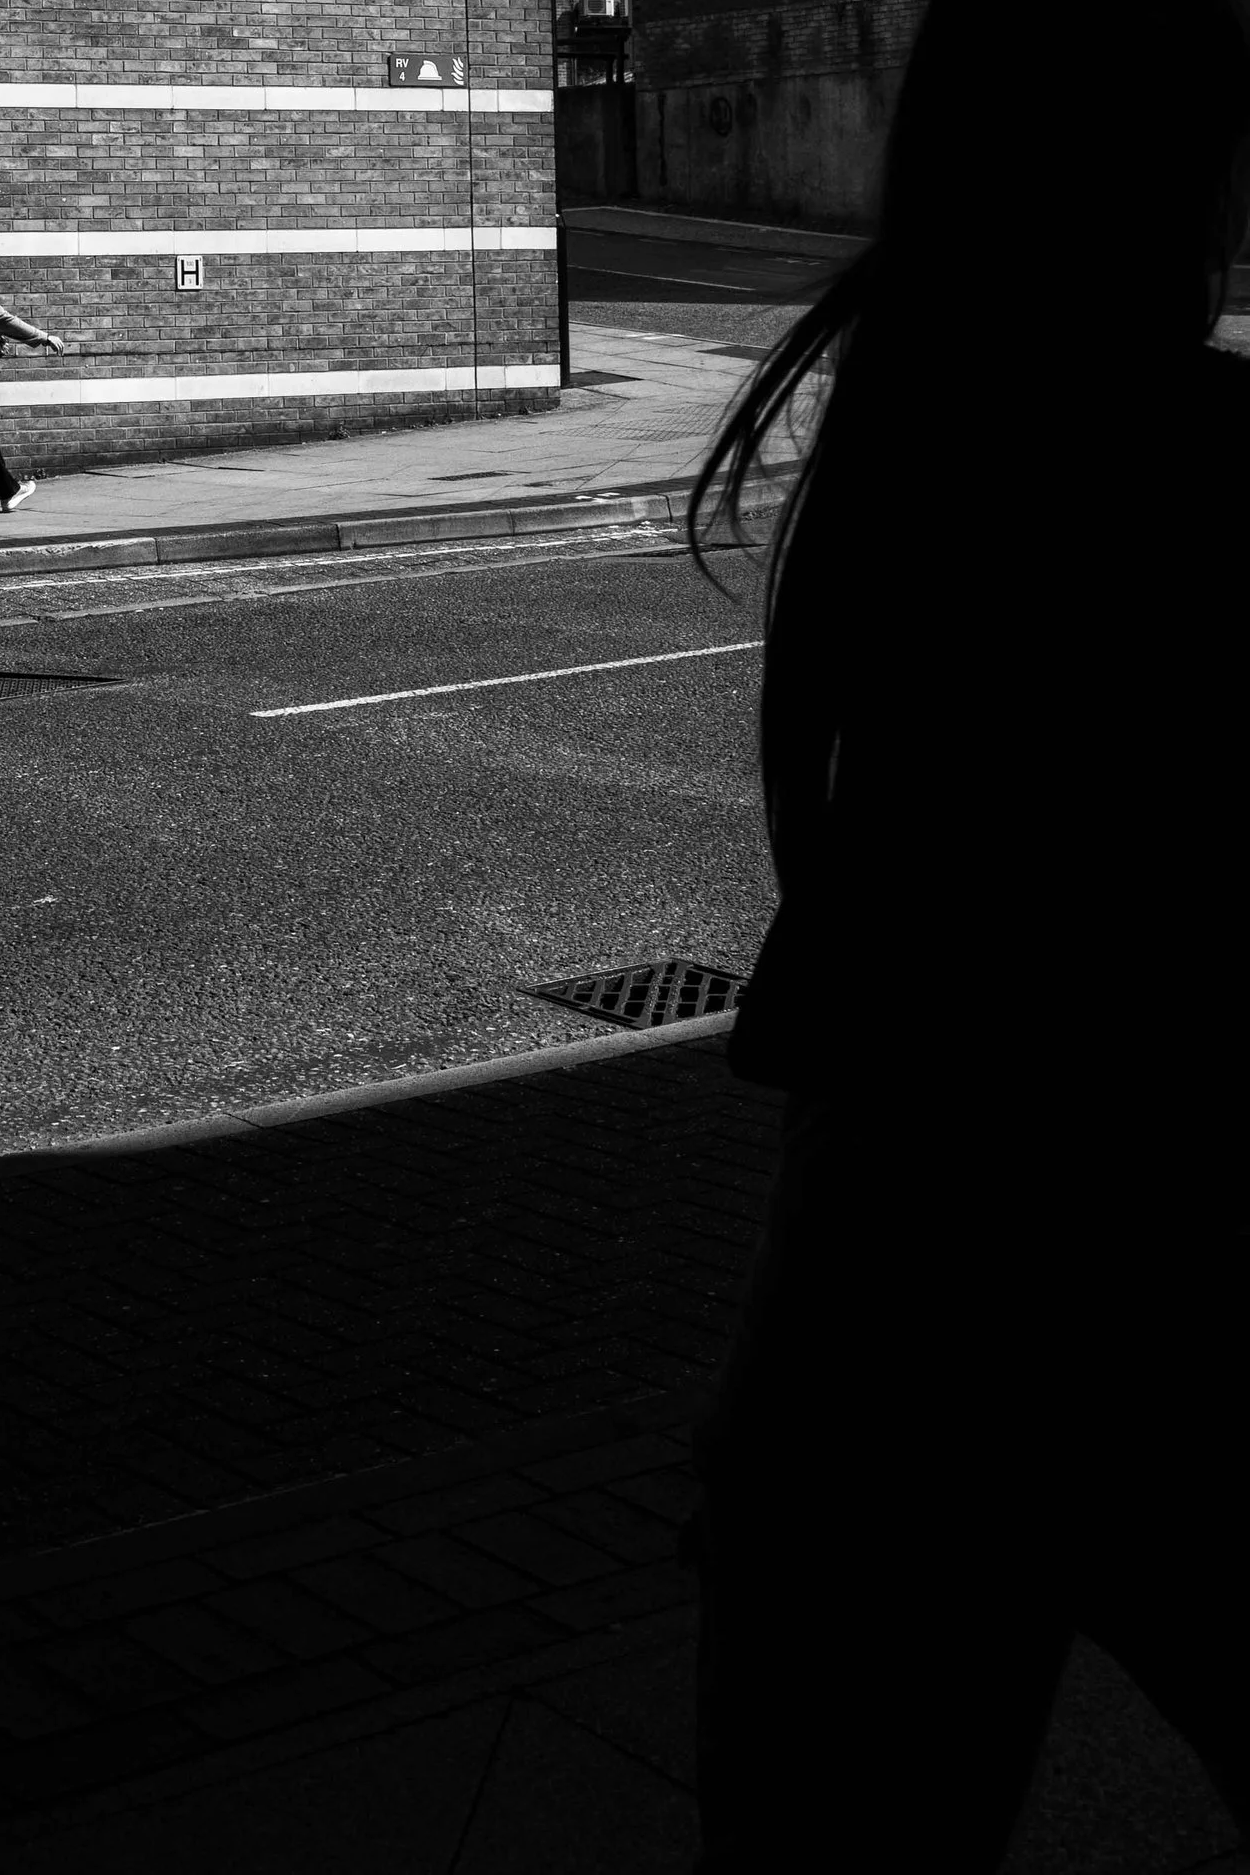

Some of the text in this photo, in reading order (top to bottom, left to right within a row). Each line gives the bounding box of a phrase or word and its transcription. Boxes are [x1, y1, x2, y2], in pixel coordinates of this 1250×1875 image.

[395, 58, 409, 68] RV
[399, 72, 406, 81] 4
[180, 259, 199, 286] H
